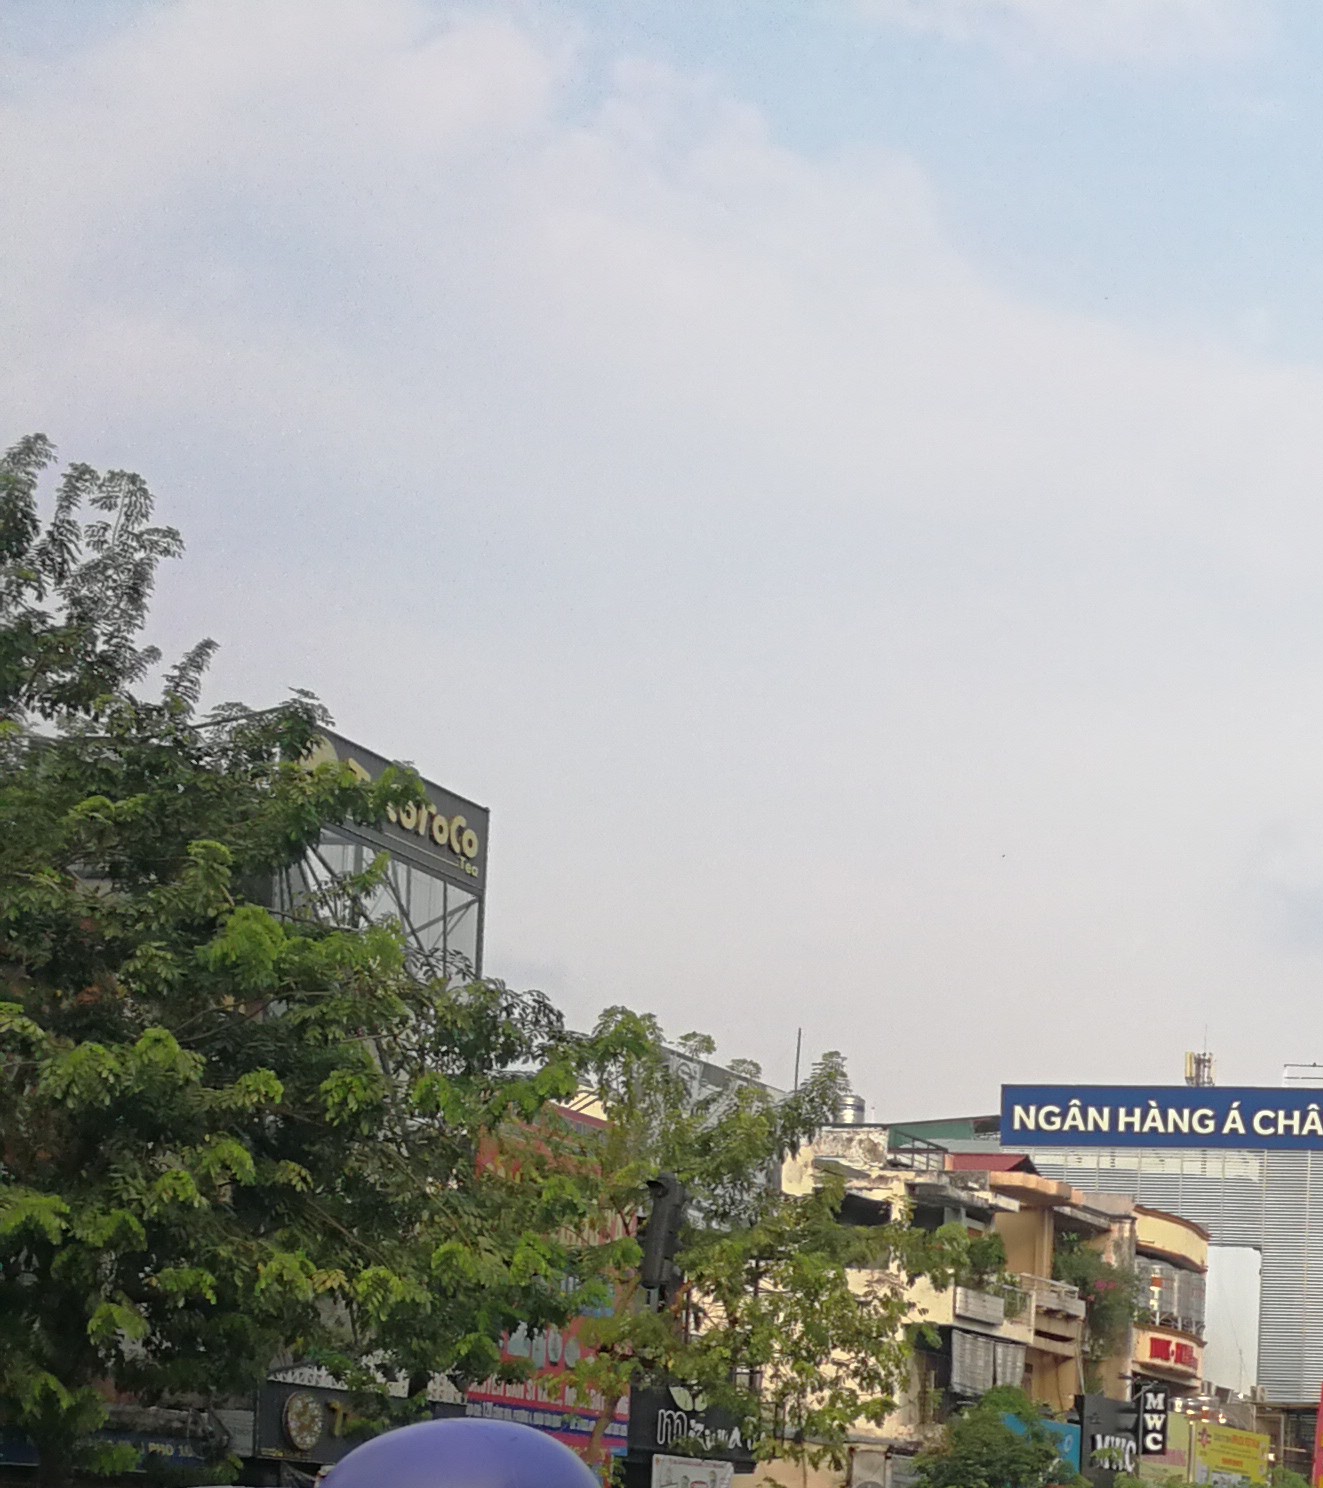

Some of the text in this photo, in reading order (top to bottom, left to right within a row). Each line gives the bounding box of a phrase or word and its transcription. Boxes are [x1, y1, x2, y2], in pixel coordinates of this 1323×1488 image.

[458, 856, 479, 878] Tea
[1012, 1099, 1111, 1133] NGÂN
[1117, 1100, 1216, 1135] HÀNG
[1222, 1101, 1246, 1136] Á
[1143, 1391, 1166, 1451] MWC
